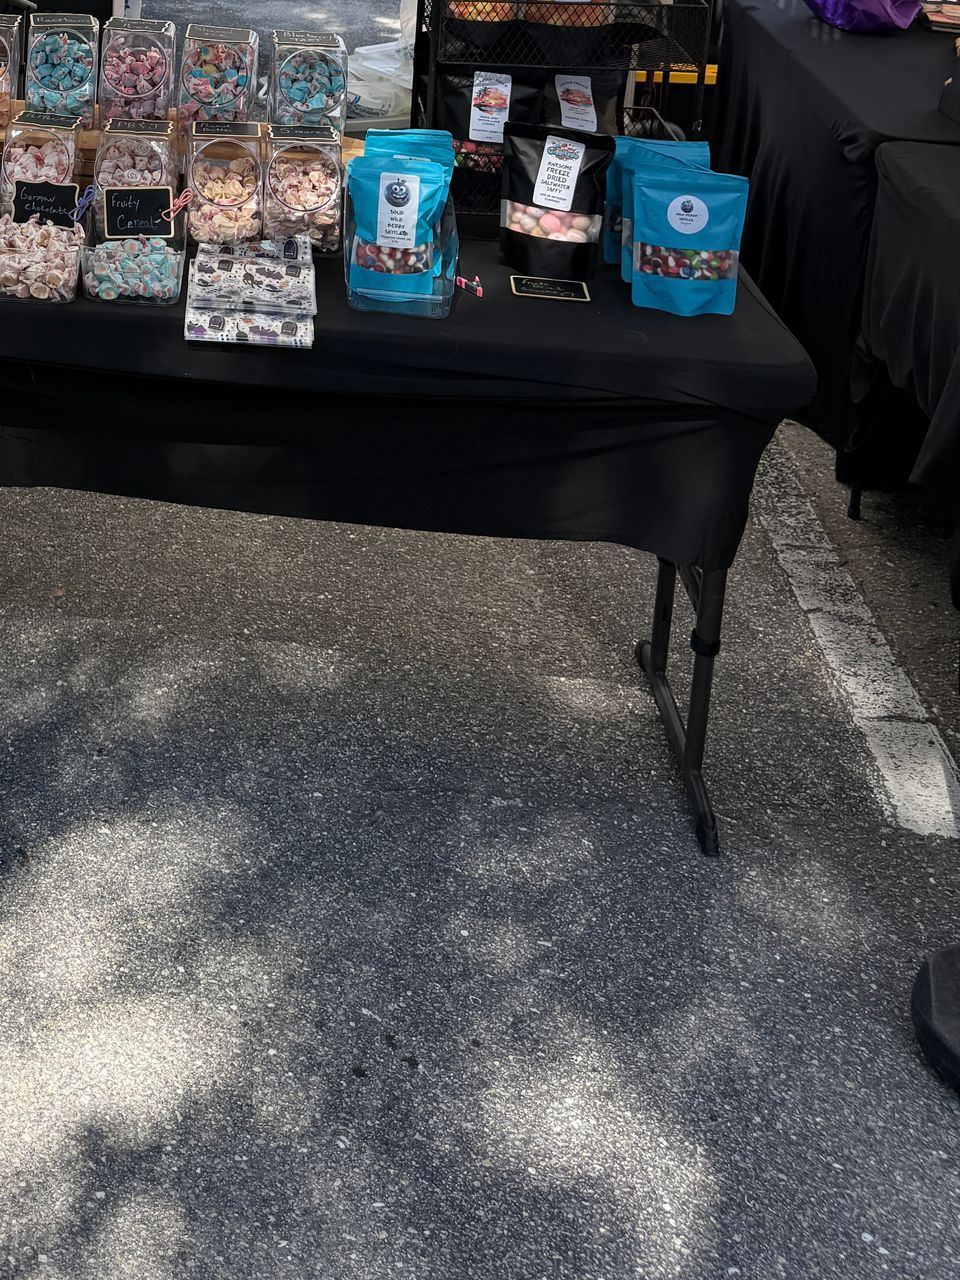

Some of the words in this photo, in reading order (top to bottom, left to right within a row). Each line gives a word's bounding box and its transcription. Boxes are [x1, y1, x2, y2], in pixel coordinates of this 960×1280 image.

[547, 161, 573, 171] AWESOME
[546, 167, 571, 178] FREEZE
[546, 173, 567, 184] DRIED
[540, 179, 571, 191] SALTWATER
[546, 186, 563, 194] TAFFY
[111, 192, 140, 212] Fruity
[116, 214, 154, 230] Cereal
